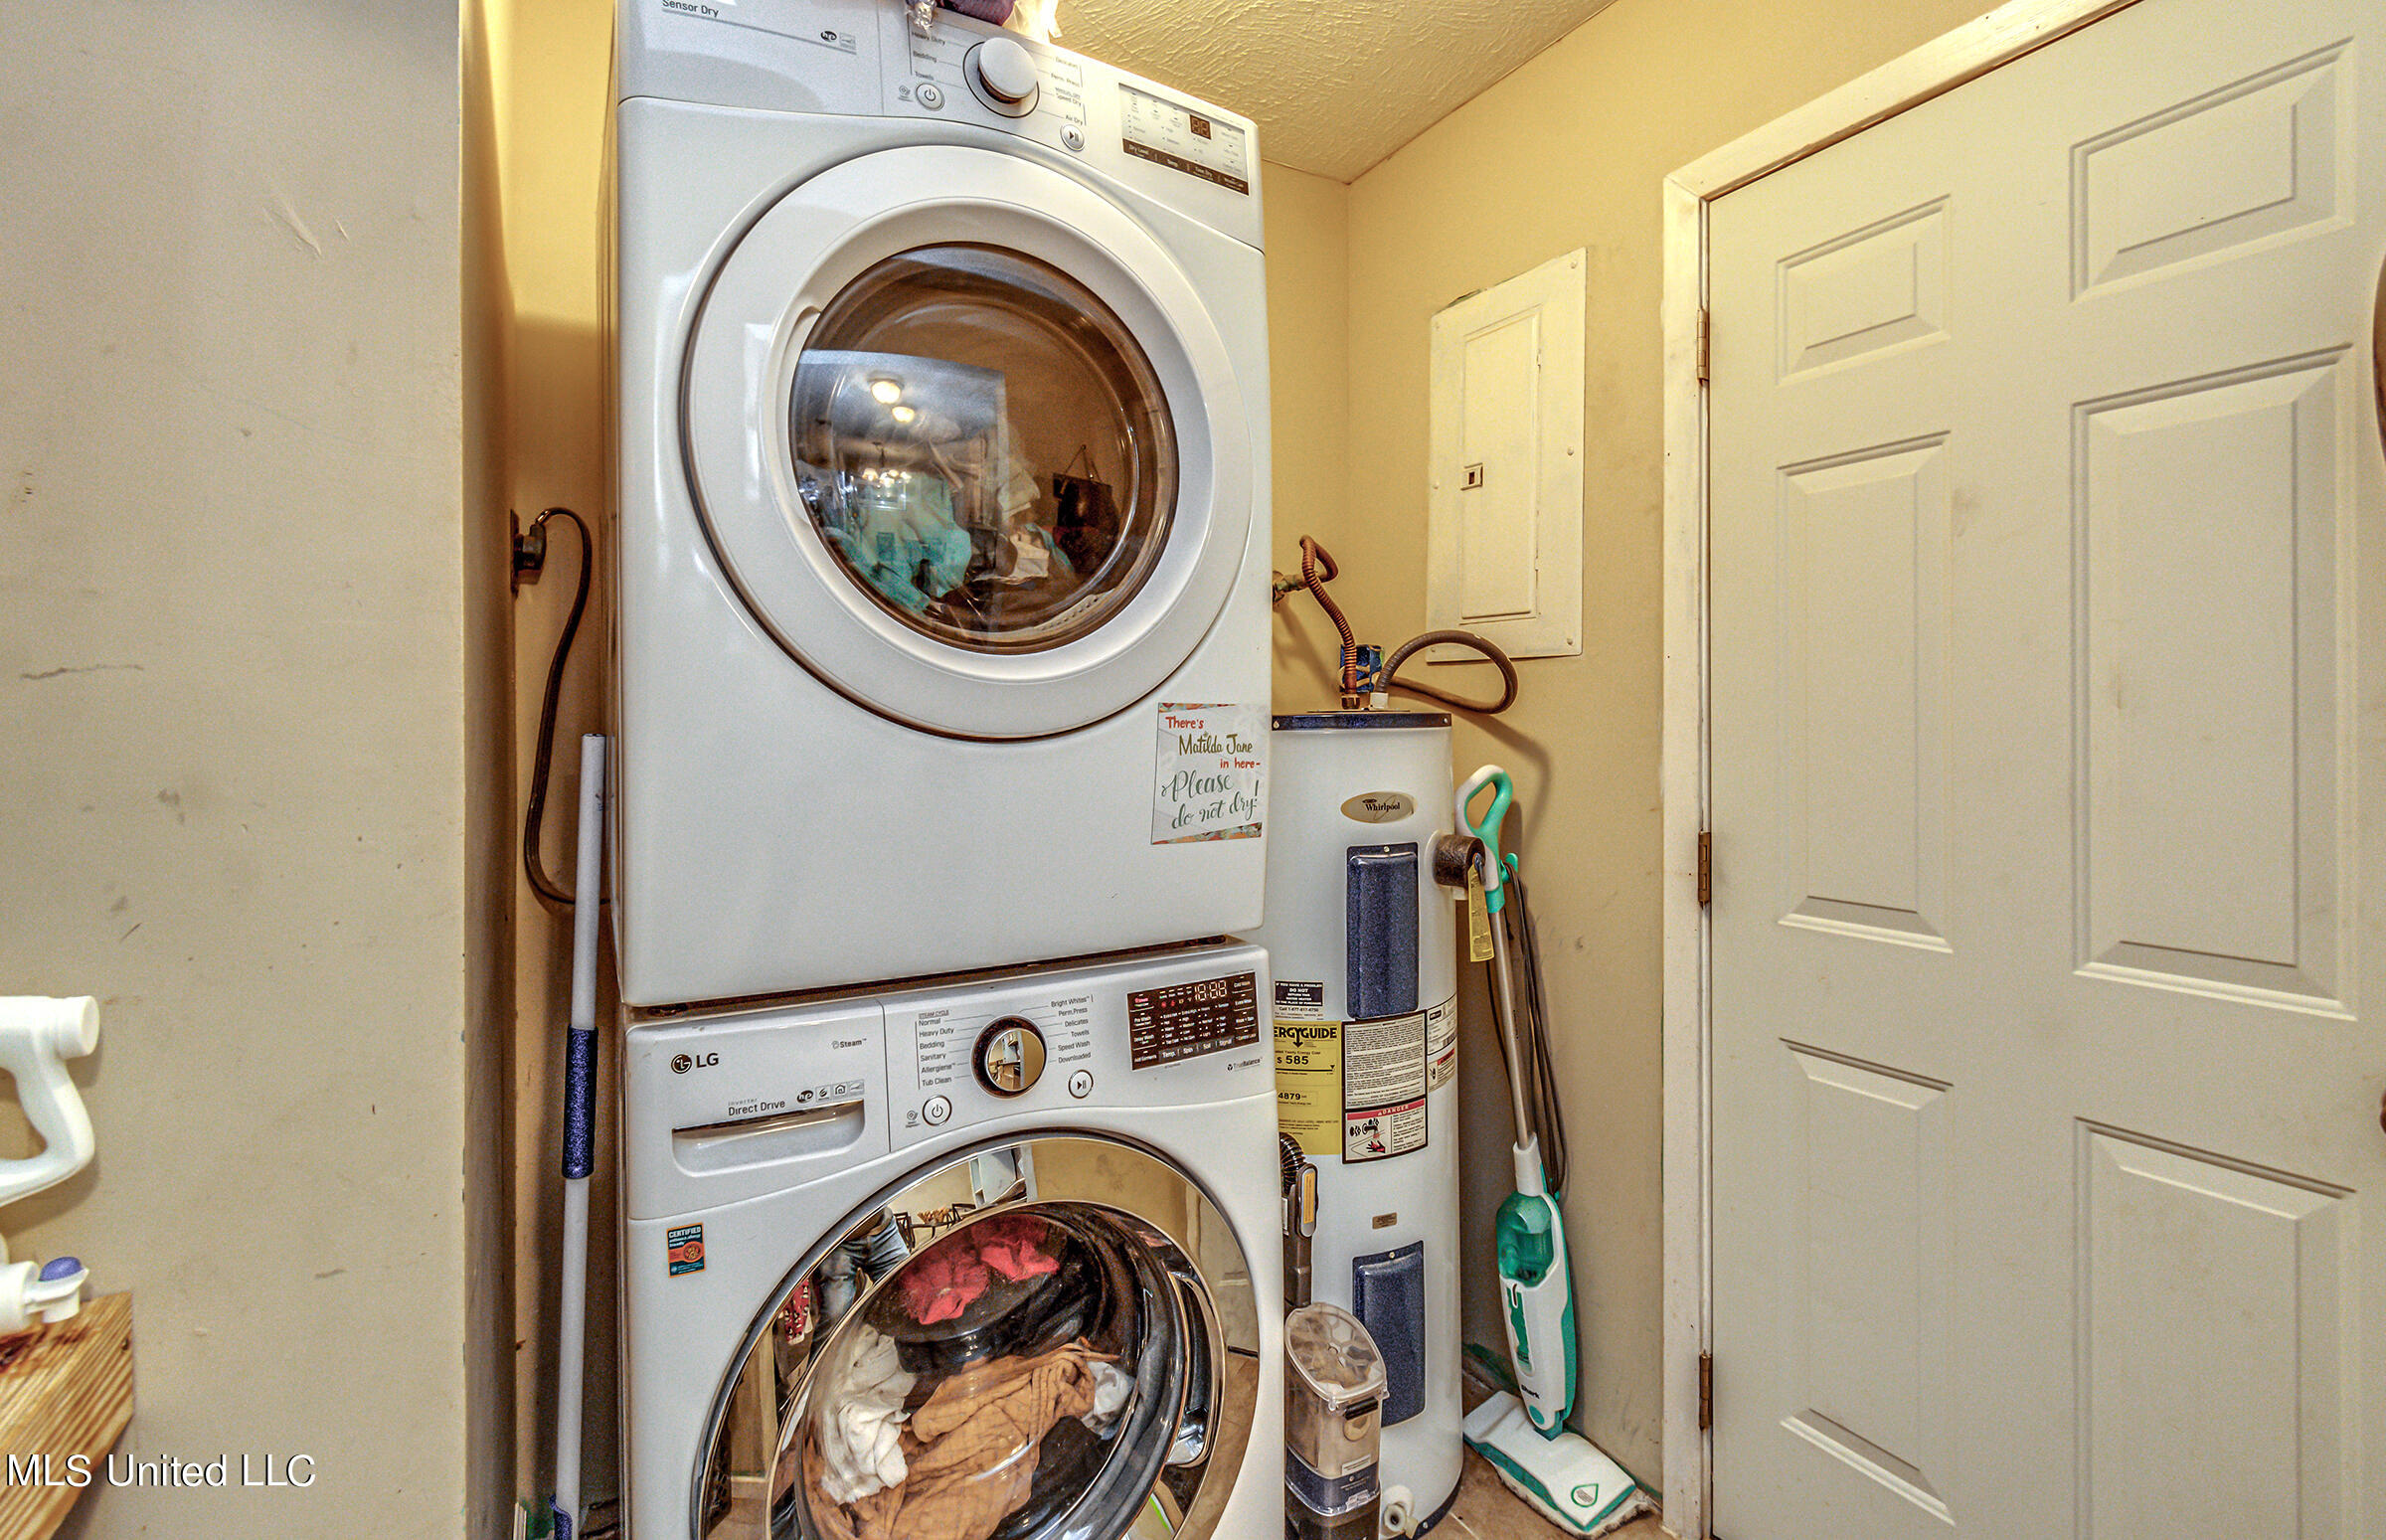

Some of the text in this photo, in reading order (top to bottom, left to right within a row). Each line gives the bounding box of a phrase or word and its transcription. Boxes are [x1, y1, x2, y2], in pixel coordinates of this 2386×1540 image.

[662, 0, 719, 18] Sensor Dry
[913, 50, 937, 63] Bedding
[1165, 716, 1204, 729] There's
[1179, 732, 1253, 756] Matilda Jane
[1220, 758, 1230, 769] in
[1161, 770, 1233, 802] Please
[1171, 779, 1260, 829] do not dry!
[1365, 802, 1401, 812] Whirlpool
[1051, 999, 1068, 1008] Bright
[919, 1018, 940, 1027] Normal
[920, 1041, 944, 1050] Bedding
[1058, 1040, 1091, 1052] Speed Wash
[696, 1052, 719, 1069] LG
[1058, 1052, 1092, 1064] Downloaded
[1277, 1055, 1309, 1065] $ 585
[935, 1076, 952, 1085] Clean
[1278, 1092, 1301, 1101] 4879
[728, 1100, 785, 1115] Direct Drive
[669, 1226, 702, 1239] CERTIFIED
